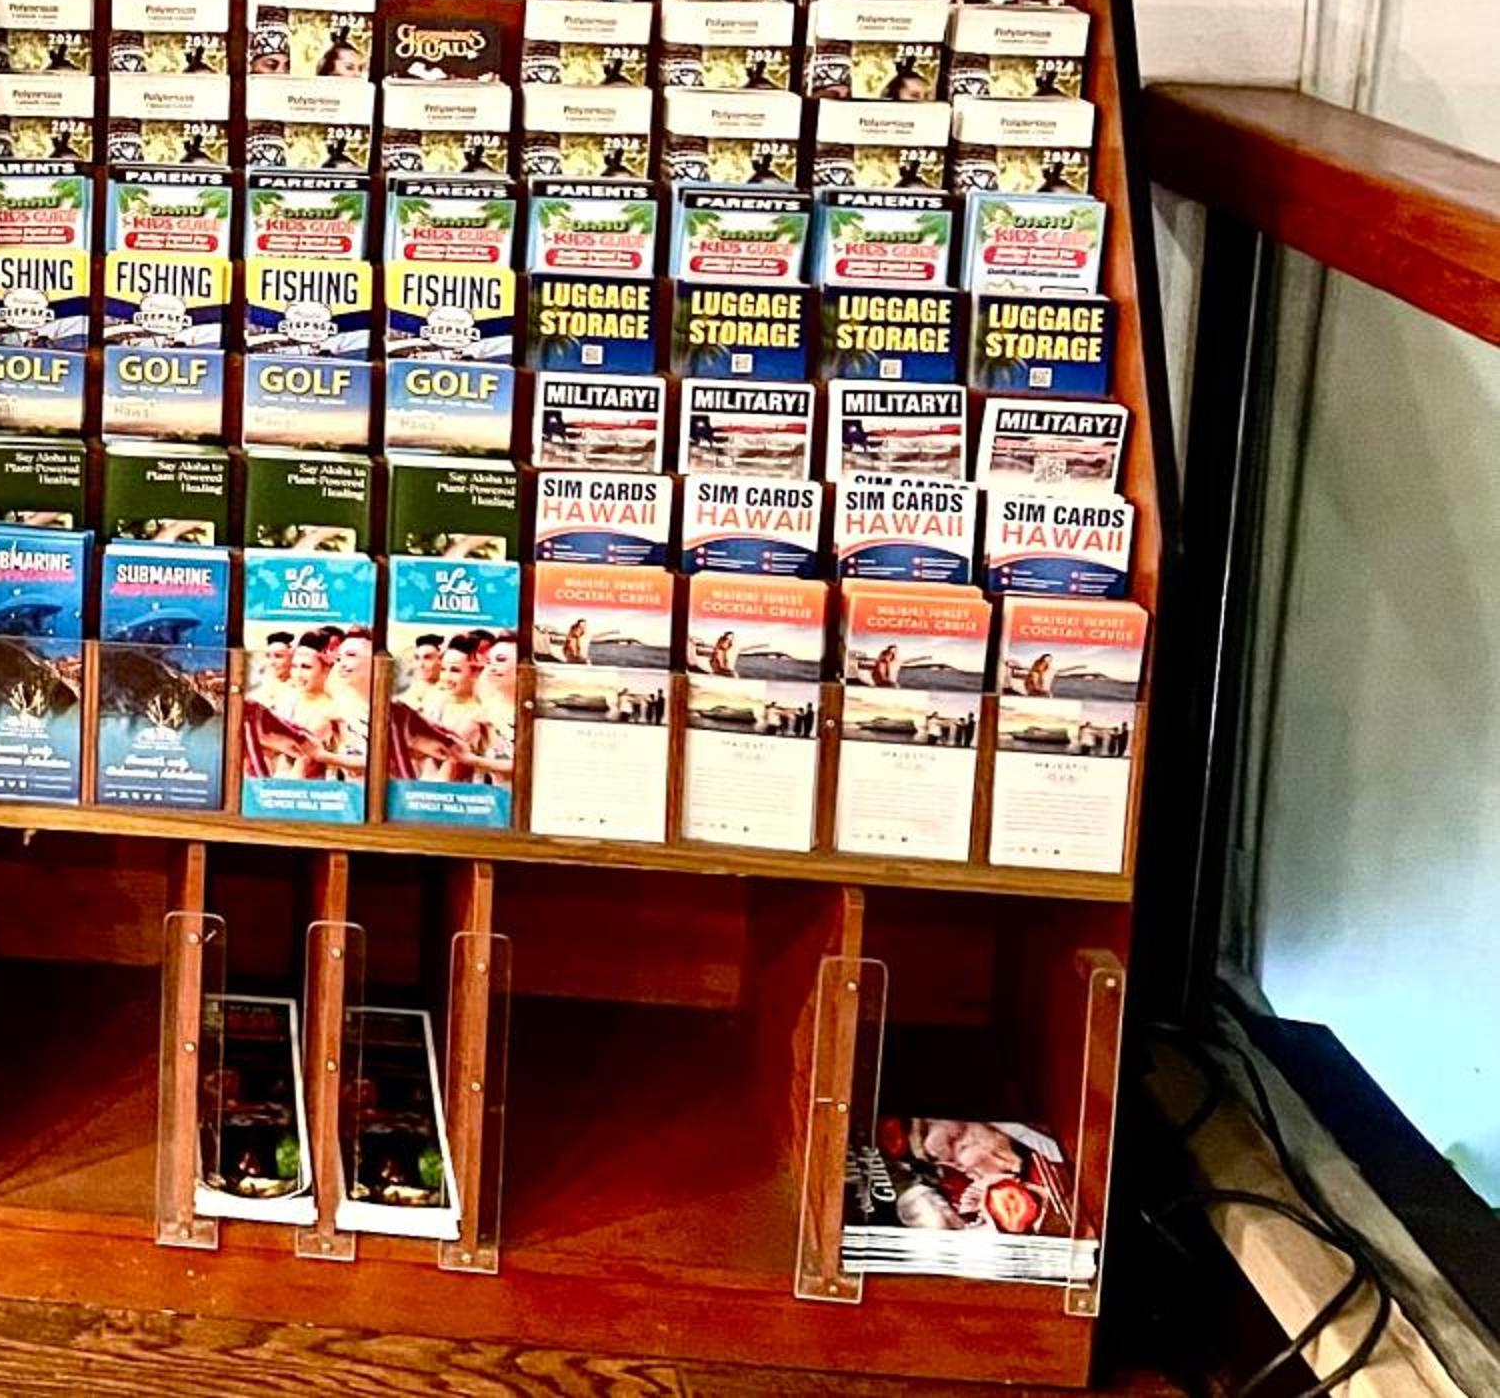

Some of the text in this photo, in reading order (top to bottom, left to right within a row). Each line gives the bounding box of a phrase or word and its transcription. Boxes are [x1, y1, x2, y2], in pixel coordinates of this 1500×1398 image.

[125, 172, 223, 184] PARENTS
[259, 177, 358, 189] PARENTS
[407, 184, 508, 197] PARENTS
[546, 186, 648, 198] PARENTS
[838, 194, 942, 208] PARENTS
[697, 198, 800, 210] PARENTS
[133, 218, 172, 230] KIDS
[266, 218, 306, 232] KIDS
[413, 228, 454, 240] KIDS
[995, 228, 1037, 242] KIDS
[554, 234, 595, 246] KIDS
[701, 242, 742, 253] KIDS
[846, 244, 887, 256] KIDS
[117, 262, 211, 297] FISHING
[262, 270, 358, 304] FISHING
[404, 274, 500, 310] FISHING
[542, 282, 650, 310] LUGGAGE
[692, 291, 801, 319] LUGGAGE
[839, 295, 951, 323] LUGGAGE
[540, 311, 649, 339] STORAGE
[989, 304, 1104, 333] LUGGAGE
[690, 320, 800, 348] STORAGE
[837, 325, 949, 353] STORAGE
[986, 333, 1102, 362] STORAGE
[119, 357, 207, 385] GOLF
[260, 367, 351, 395] GOLF
[406, 370, 498, 399] GOLF
[547, 384, 655, 409] MILITARY!
[695, 389, 805, 412] MILITARY!
[845, 393, 958, 414] MILITARY!
[1000, 410, 1117, 434] MILITARY!
[543, 479, 657, 501] SIM CARDS
[698, 484, 814, 508] SIM CARDS
[846, 491, 963, 512] SIM CARDS
[543, 500, 655, 524] HAWAII
[696, 504, 812, 532] HAWAII
[1003, 502, 1125, 528] SIM CARDS
[846, 514, 963, 537] HAWAII
[1002, 525, 1122, 552] HAWAII
[117, 565, 211, 586] SUBMARINE
